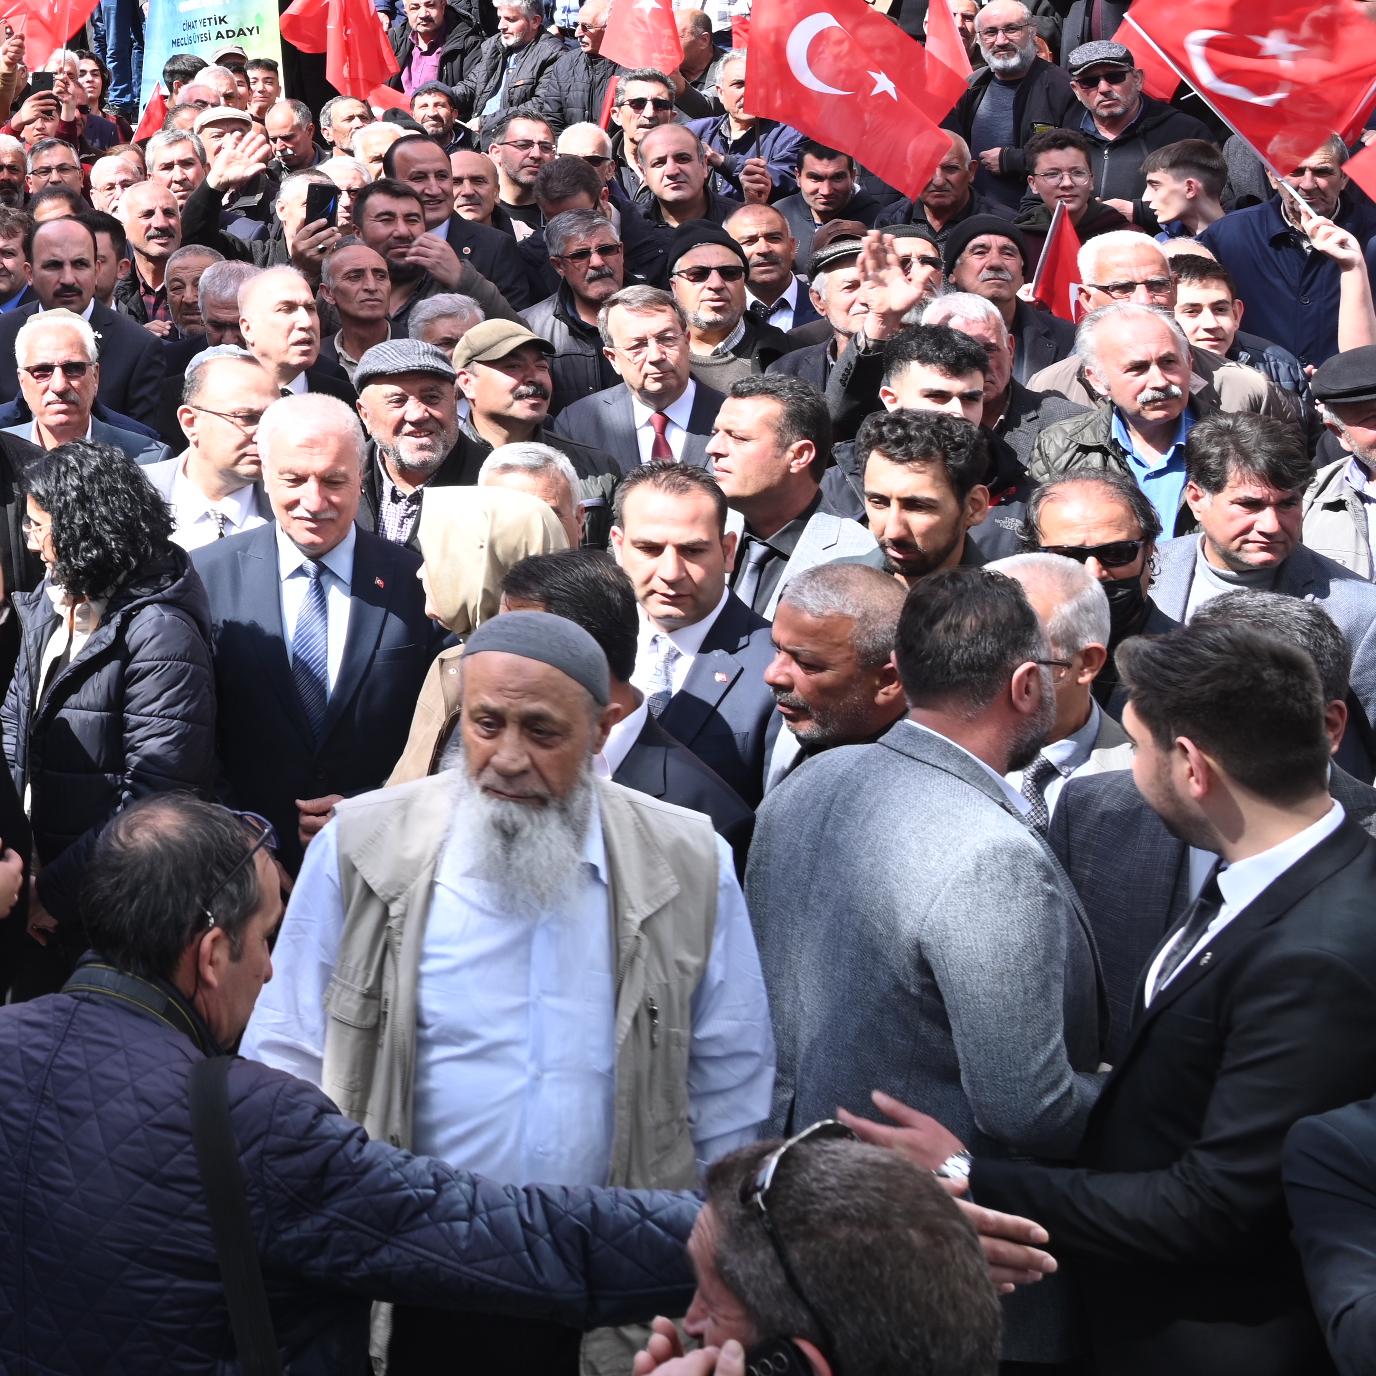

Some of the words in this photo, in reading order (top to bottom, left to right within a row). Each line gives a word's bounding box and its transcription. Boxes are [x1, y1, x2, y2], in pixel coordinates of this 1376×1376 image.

[183, 19, 197, 32] CİHAT
[199, 15, 229, 28] YETİK
[215, 25, 260, 40] ADAYI
